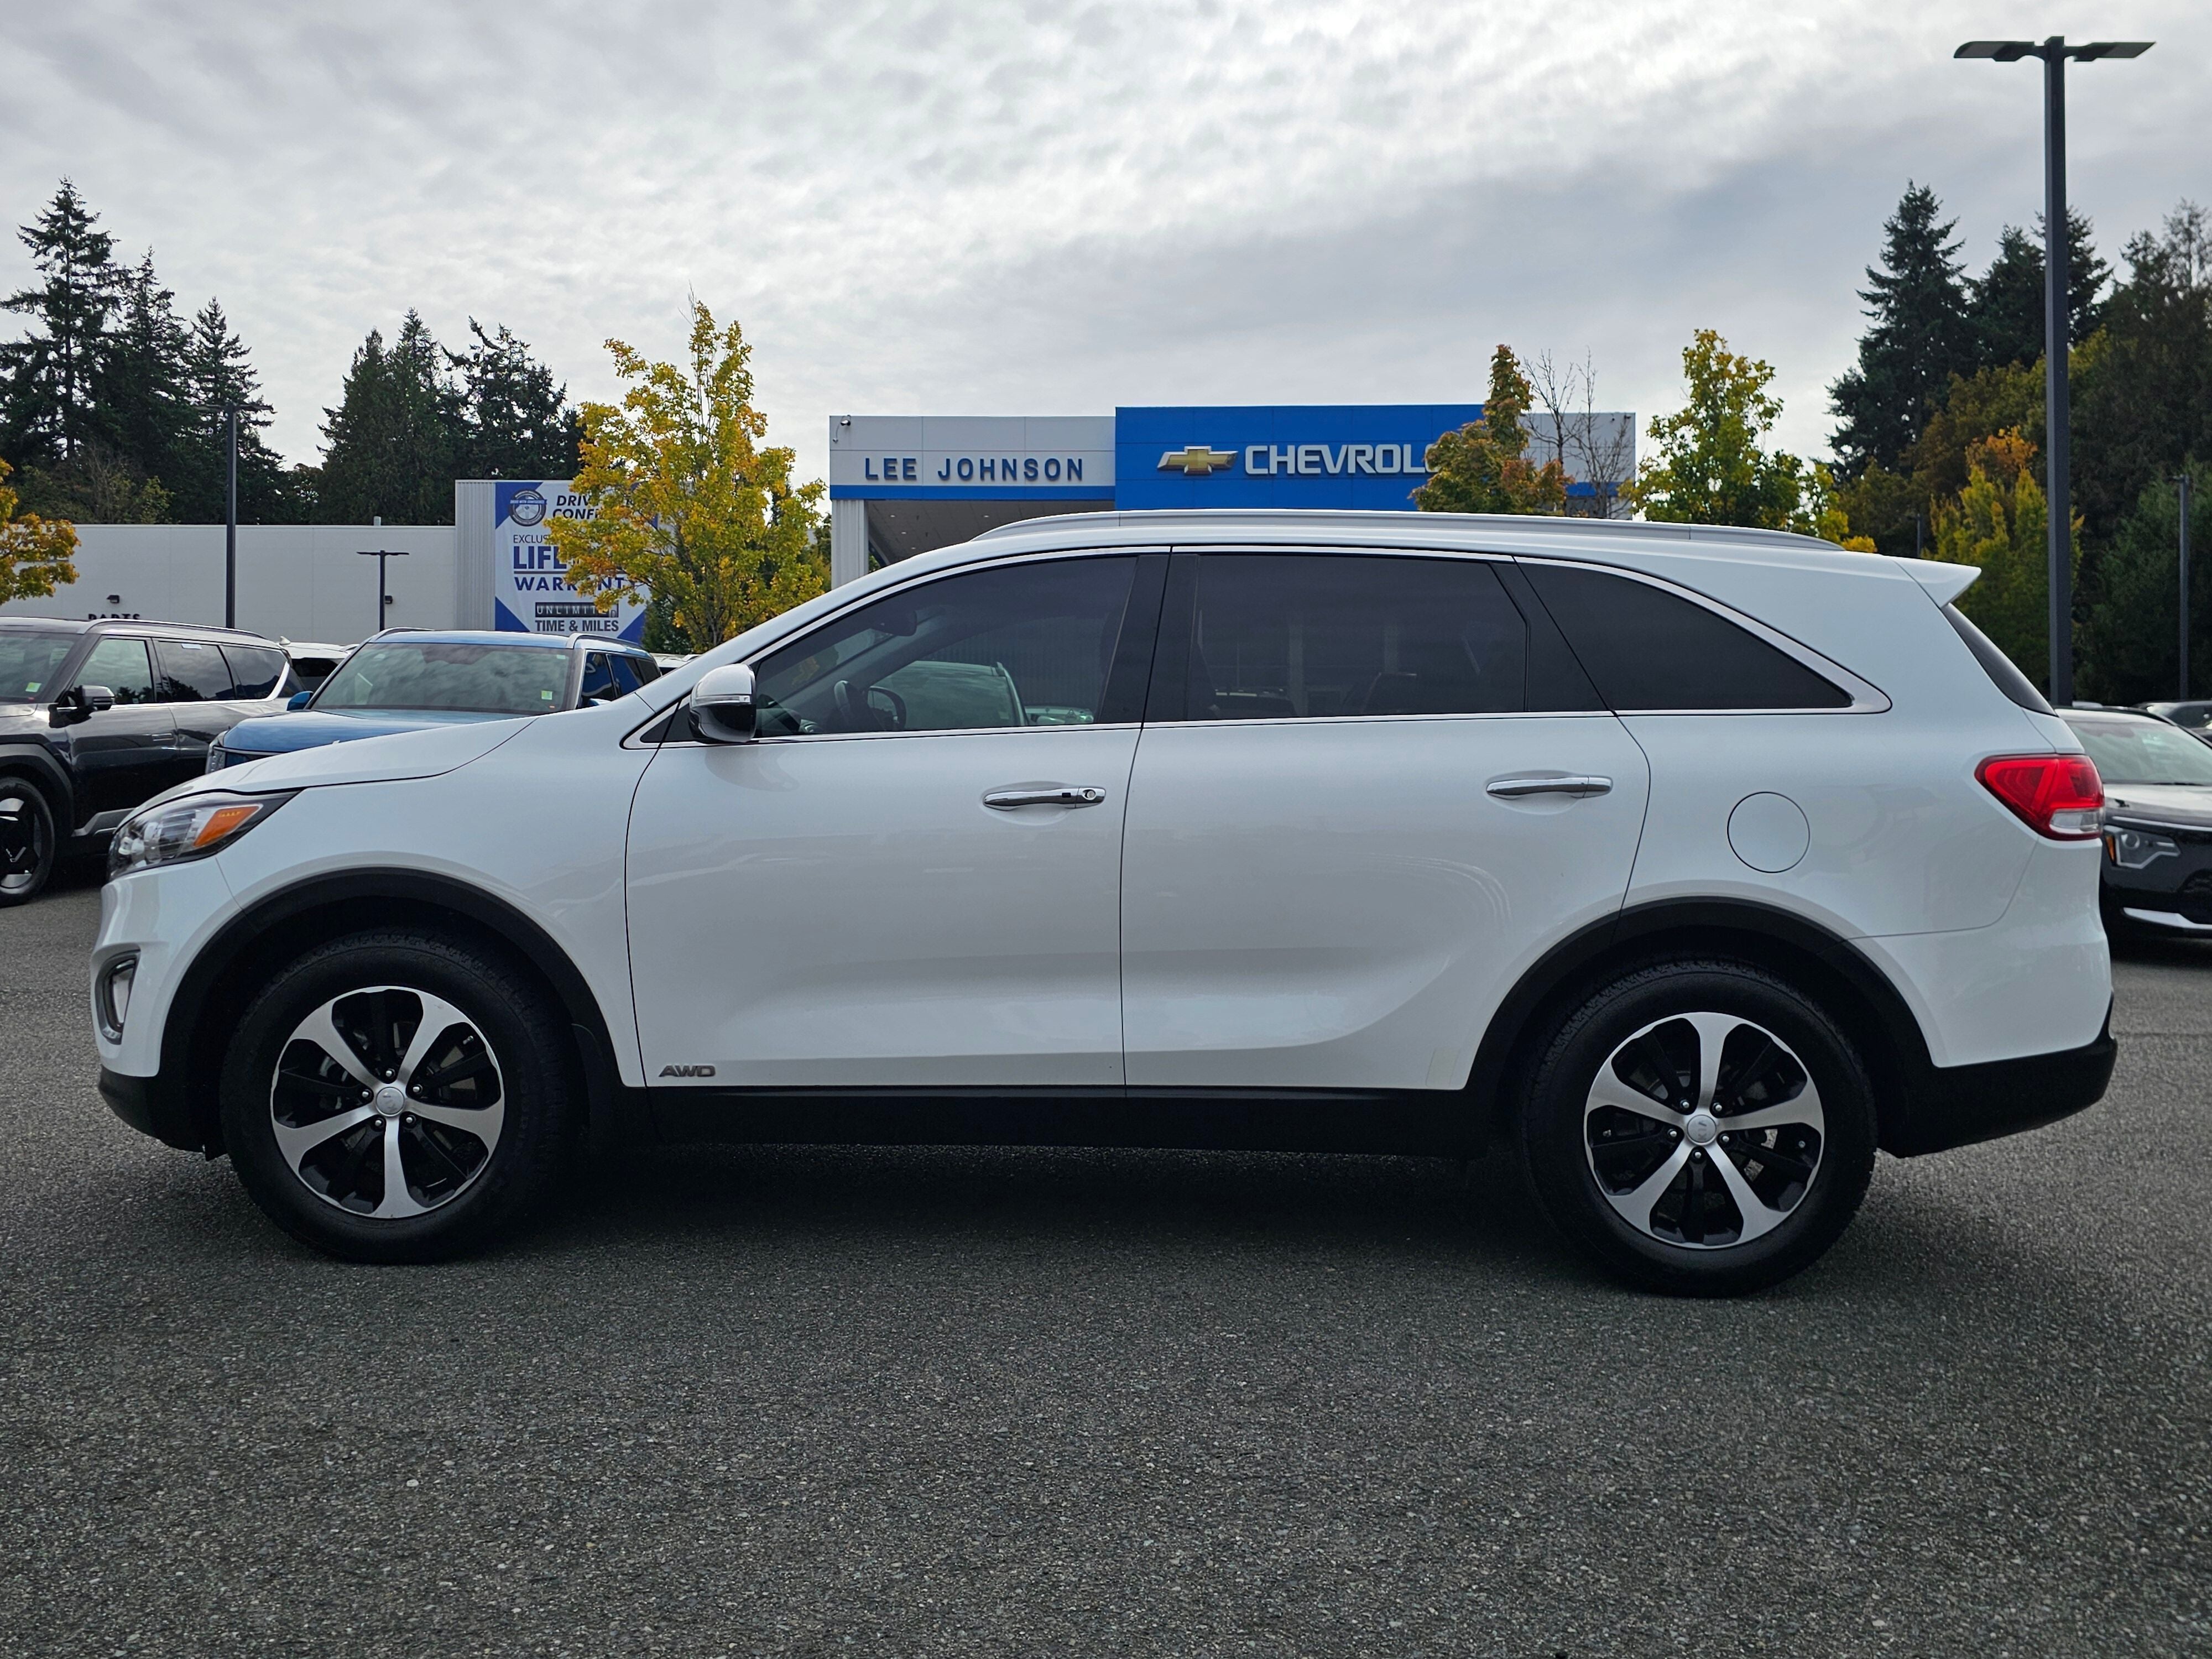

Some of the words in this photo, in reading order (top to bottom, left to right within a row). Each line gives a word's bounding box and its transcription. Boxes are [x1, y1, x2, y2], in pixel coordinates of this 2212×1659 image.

[1245, 444, 1439, 474] CHEVROL
[865, 457, 917, 481] LEE
[937, 457, 1083, 481] JOHNSON
[556, 494, 599, 507] DRIV
[513, 534, 548, 544] EXCLUS
[513, 545, 567, 570] LIFE
[514, 576, 636, 591] WARRNT
[536, 605, 617, 618] UNLIMITD
[535, 620, 565, 632] TIME
[568, 619, 578, 632] &
[582, 619, 619, 632] MILES
[658, 1065, 717, 1077] AWD
